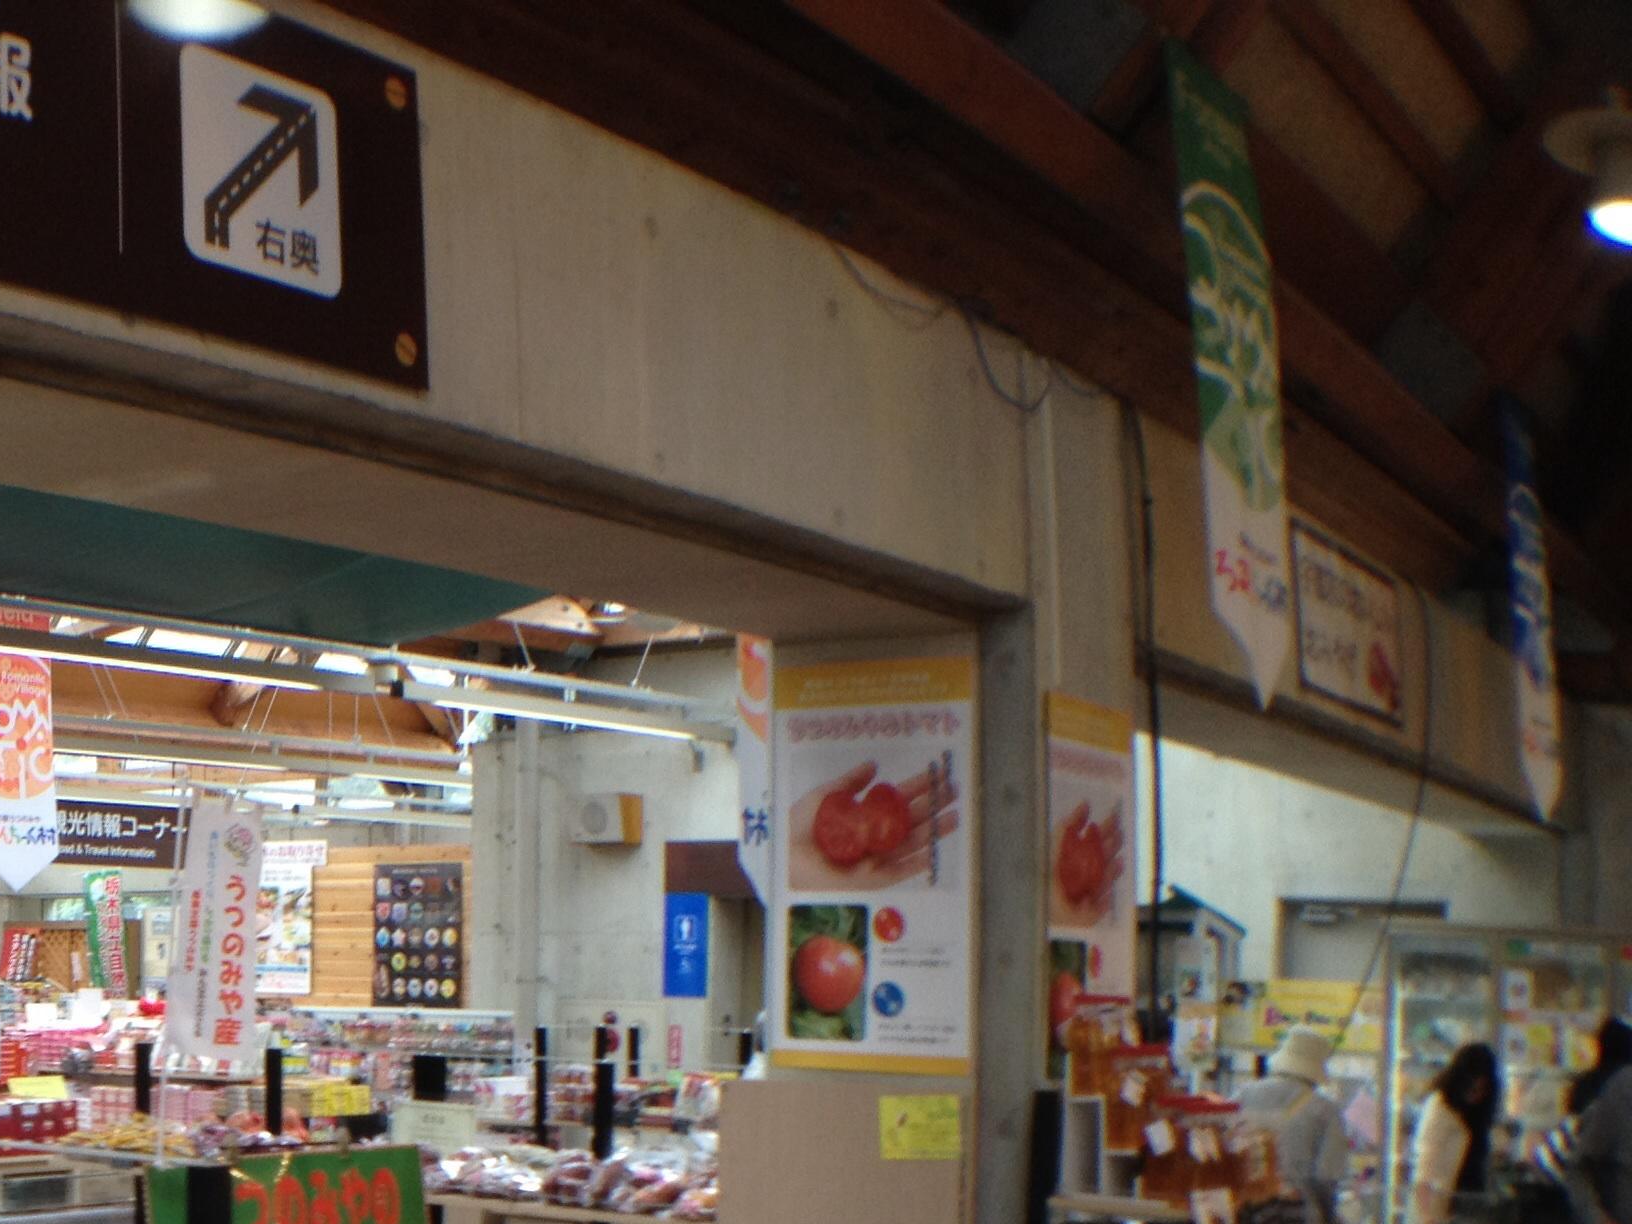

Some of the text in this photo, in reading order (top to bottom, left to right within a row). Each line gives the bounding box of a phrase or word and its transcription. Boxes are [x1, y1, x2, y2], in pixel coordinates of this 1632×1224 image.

[254, 217, 320, 277] 右奥
[213, 874, 247, 1046] うつのみや産
